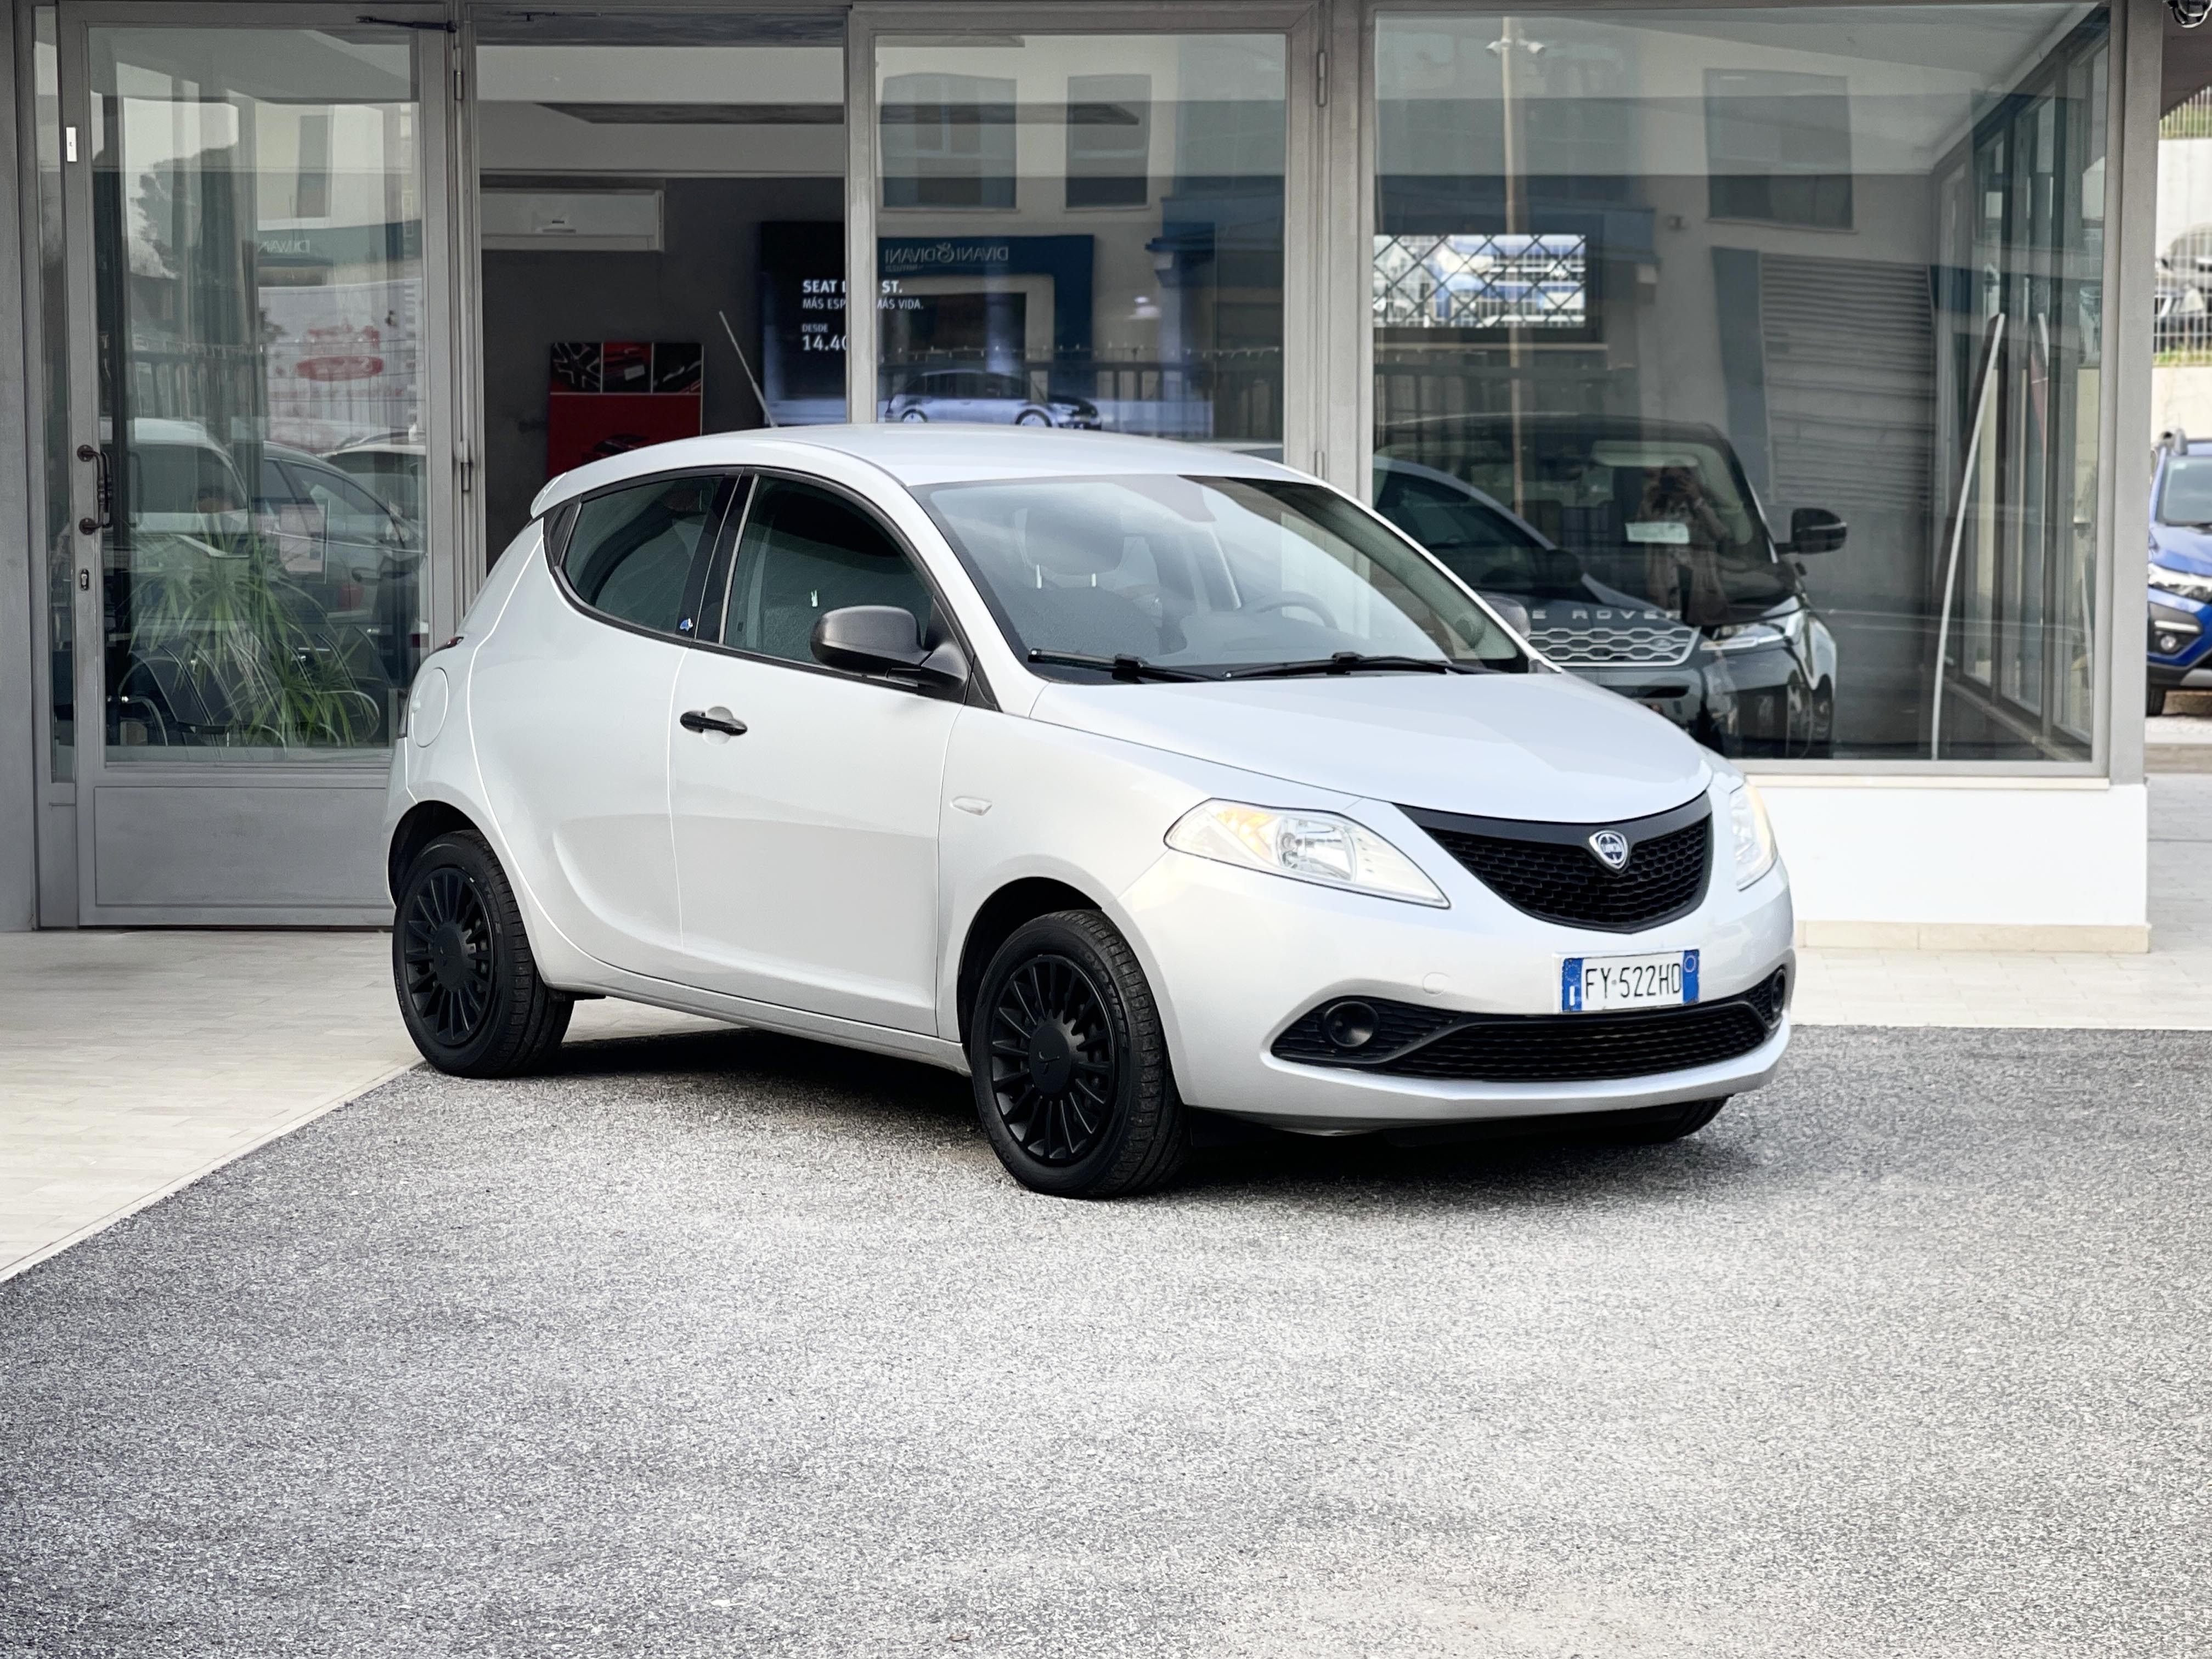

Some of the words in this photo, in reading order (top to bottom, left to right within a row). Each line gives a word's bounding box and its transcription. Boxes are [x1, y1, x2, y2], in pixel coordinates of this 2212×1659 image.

[803, 280, 838, 293] SEAT
[882, 280, 903, 294] ST.
[803, 296, 825, 309] MÁS
[898, 298, 924, 309] VIDA.
[802, 324, 828, 332] DESDE
[1572, 610, 1681, 619] ROVER
[1585, 967, 1612, 1000] FY
